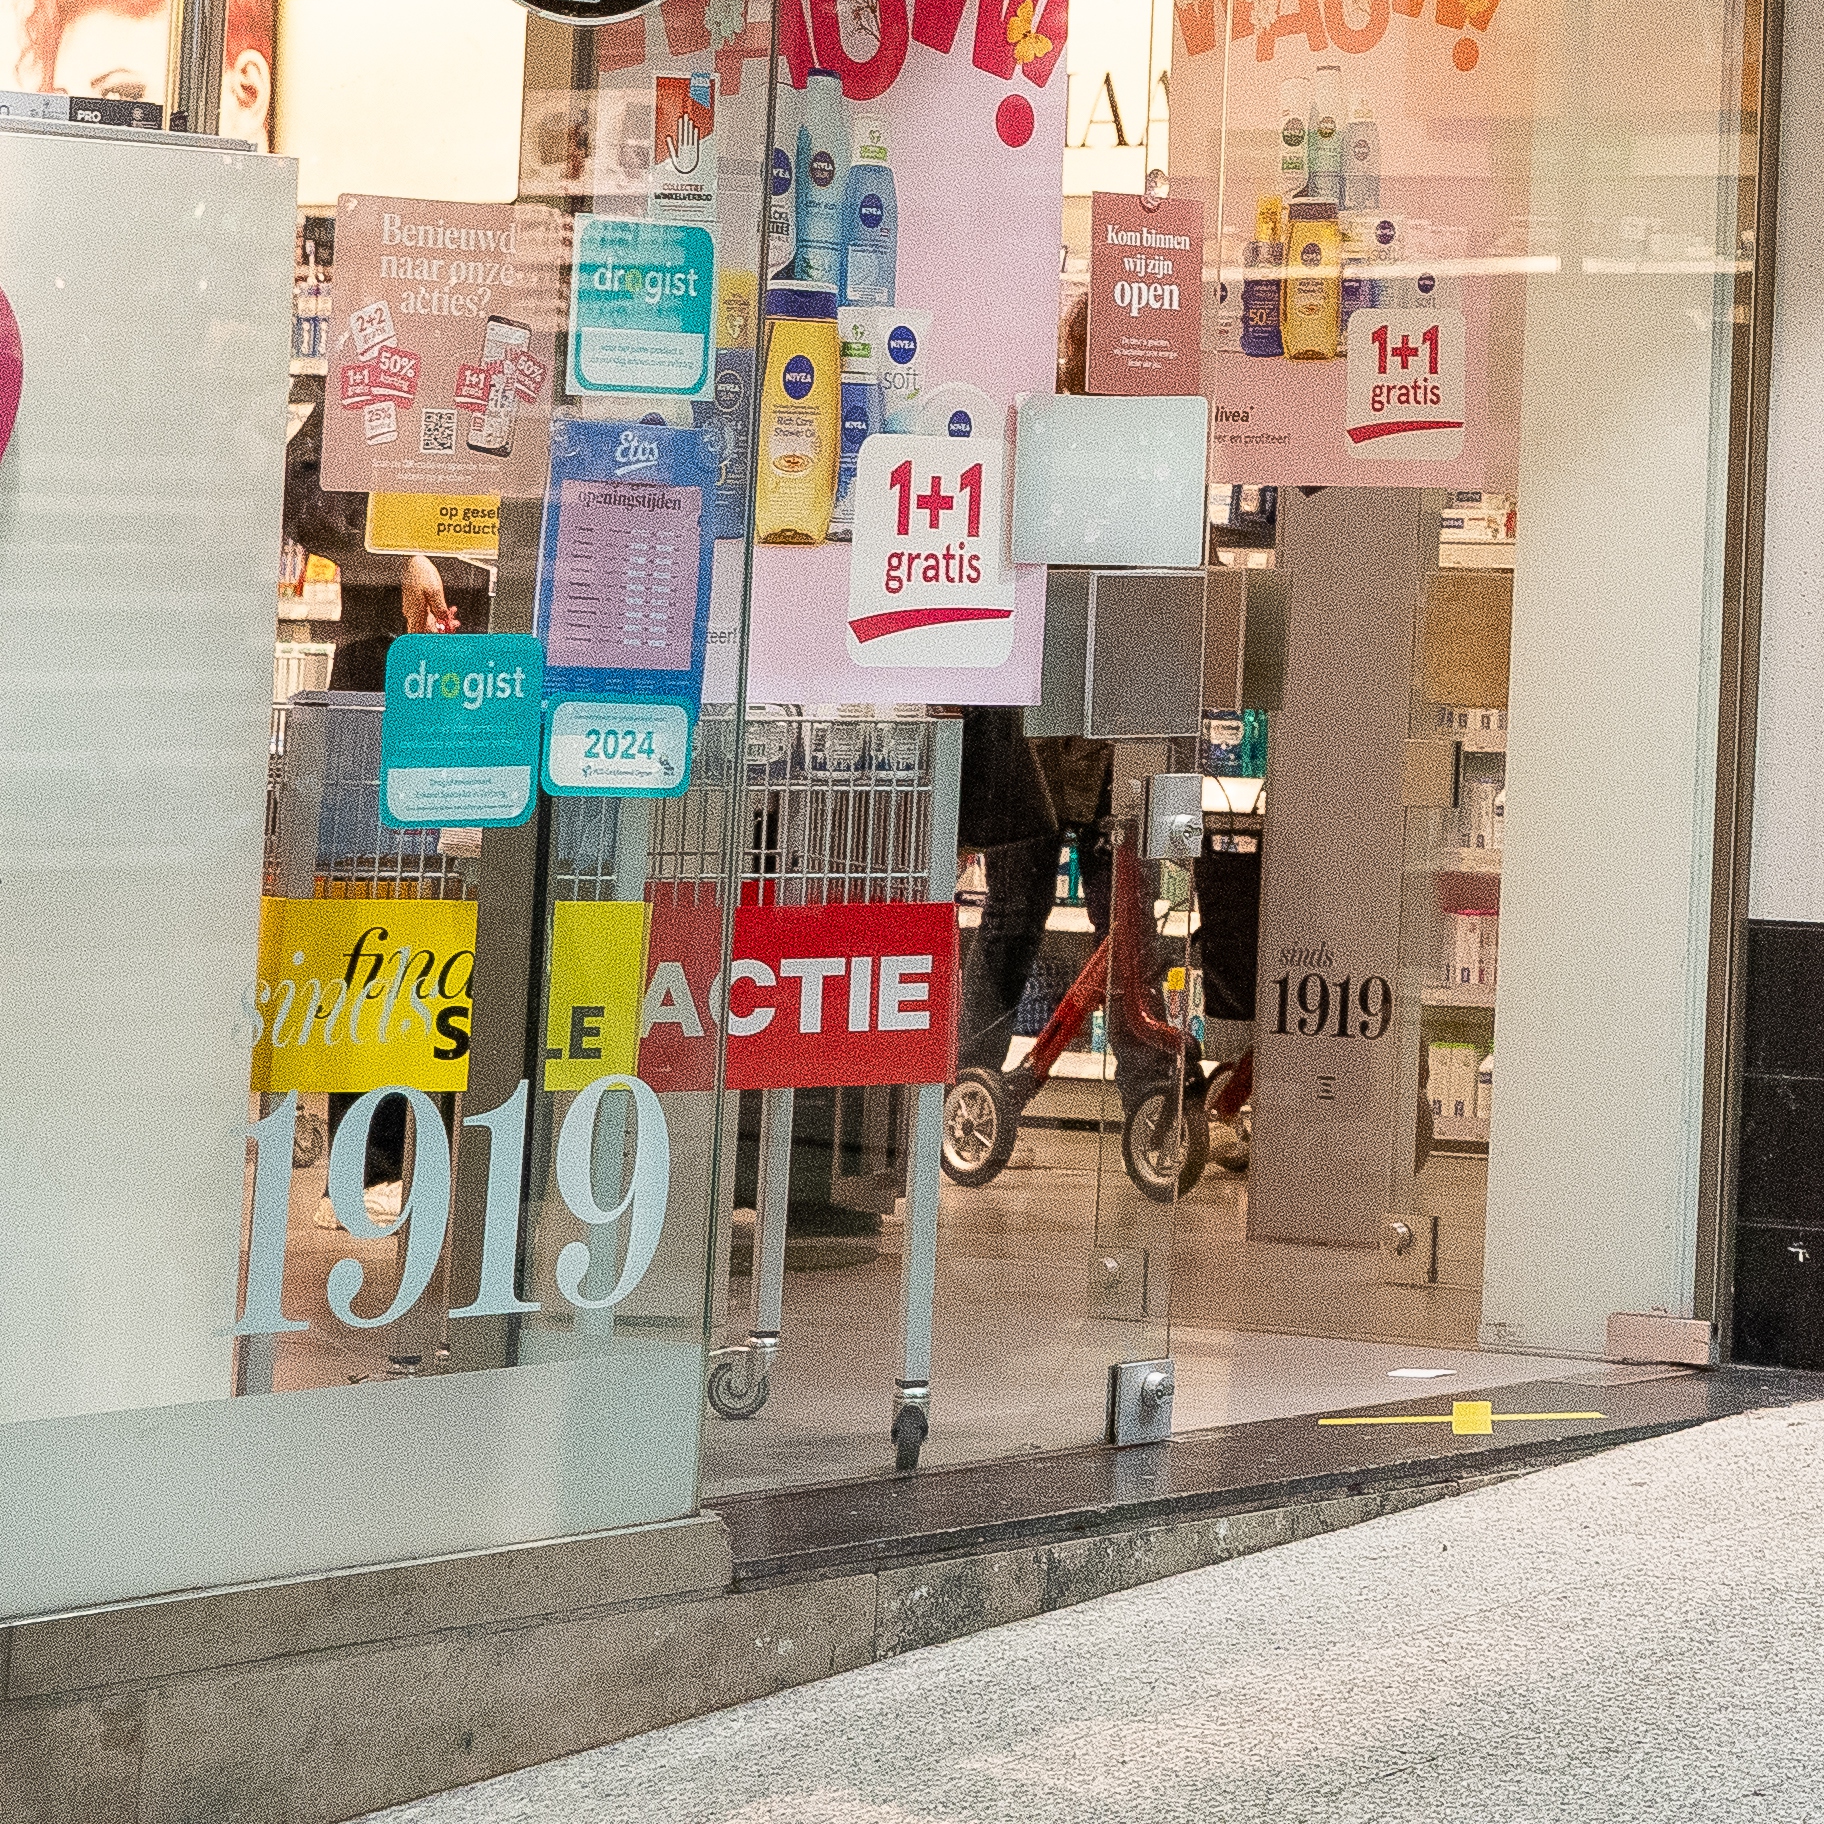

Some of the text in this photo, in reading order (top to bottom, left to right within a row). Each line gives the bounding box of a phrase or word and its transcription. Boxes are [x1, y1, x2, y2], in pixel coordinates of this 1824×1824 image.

[380, 212, 517, 255] Benieuwd
[1106, 224, 1191, 250] Kom binnen
[379, 254, 516, 288] naar onze
[592, 254, 700, 304] drogist
[1123, 253, 1174, 279] wij zijn
[400, 286, 492, 319] acties?
[1113, 280, 1181, 318] open
[890, 338, 916, 350] NIVEA
[1370, 323, 1440, 375] 1+1
[378, 351, 417, 379] 50%
[785, 372, 813, 384] NIVEA
[1370, 375, 1442, 413] gratis
[615, 430, 660, 462] Etos
[438, 506, 459, 521] op
[577, 489, 683, 513] openingstijden
[889, 459, 983, 538] 1+1
[435, 520, 501, 537] product
[884, 540, 982, 595] gratis
[403, 659, 527, 712] drogist
[583, 727, 656, 761] 2024
[1280, 940, 1335, 968] sinds
[638, 954, 932, 1039] ACTIE
[1269, 972, 1394, 1042] 1919
[216, 1074, 672, 1338] 1919
